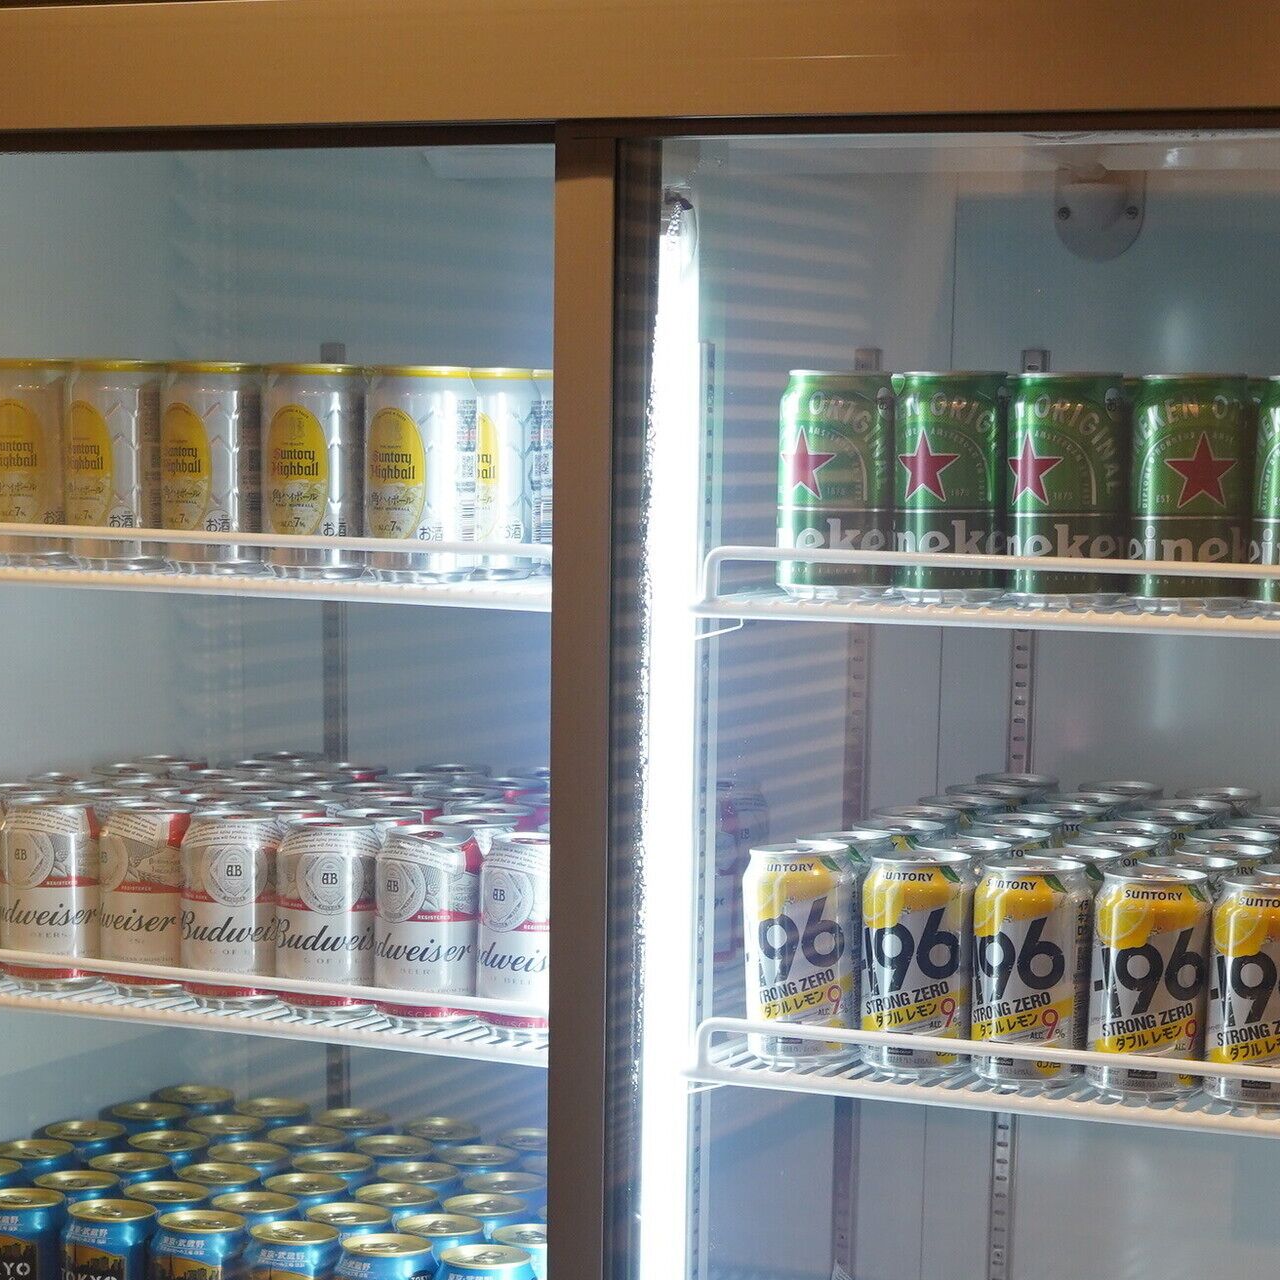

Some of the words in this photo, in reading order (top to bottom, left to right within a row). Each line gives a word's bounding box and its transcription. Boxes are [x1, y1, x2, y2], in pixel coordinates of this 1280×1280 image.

[273, 448, 315, 462] Suntory
[372, 450, 412, 465] Suntory
[1125, 890, 1183, 901] SUNTORY
[799, 968, 835, 994] ZERO
[866, 993, 910, 1015] STRONG
[912, 981, 950, 1002] ZERO
[973, 1002, 1012, 1023] STRONG
[1014, 992, 1051, 1012] ZERO
[1102, 1015, 1156, 1037] STRONG
[1158, 1003, 1194, 1025] ZERO
[1217, 1024, 1269, 1046] STRONG
